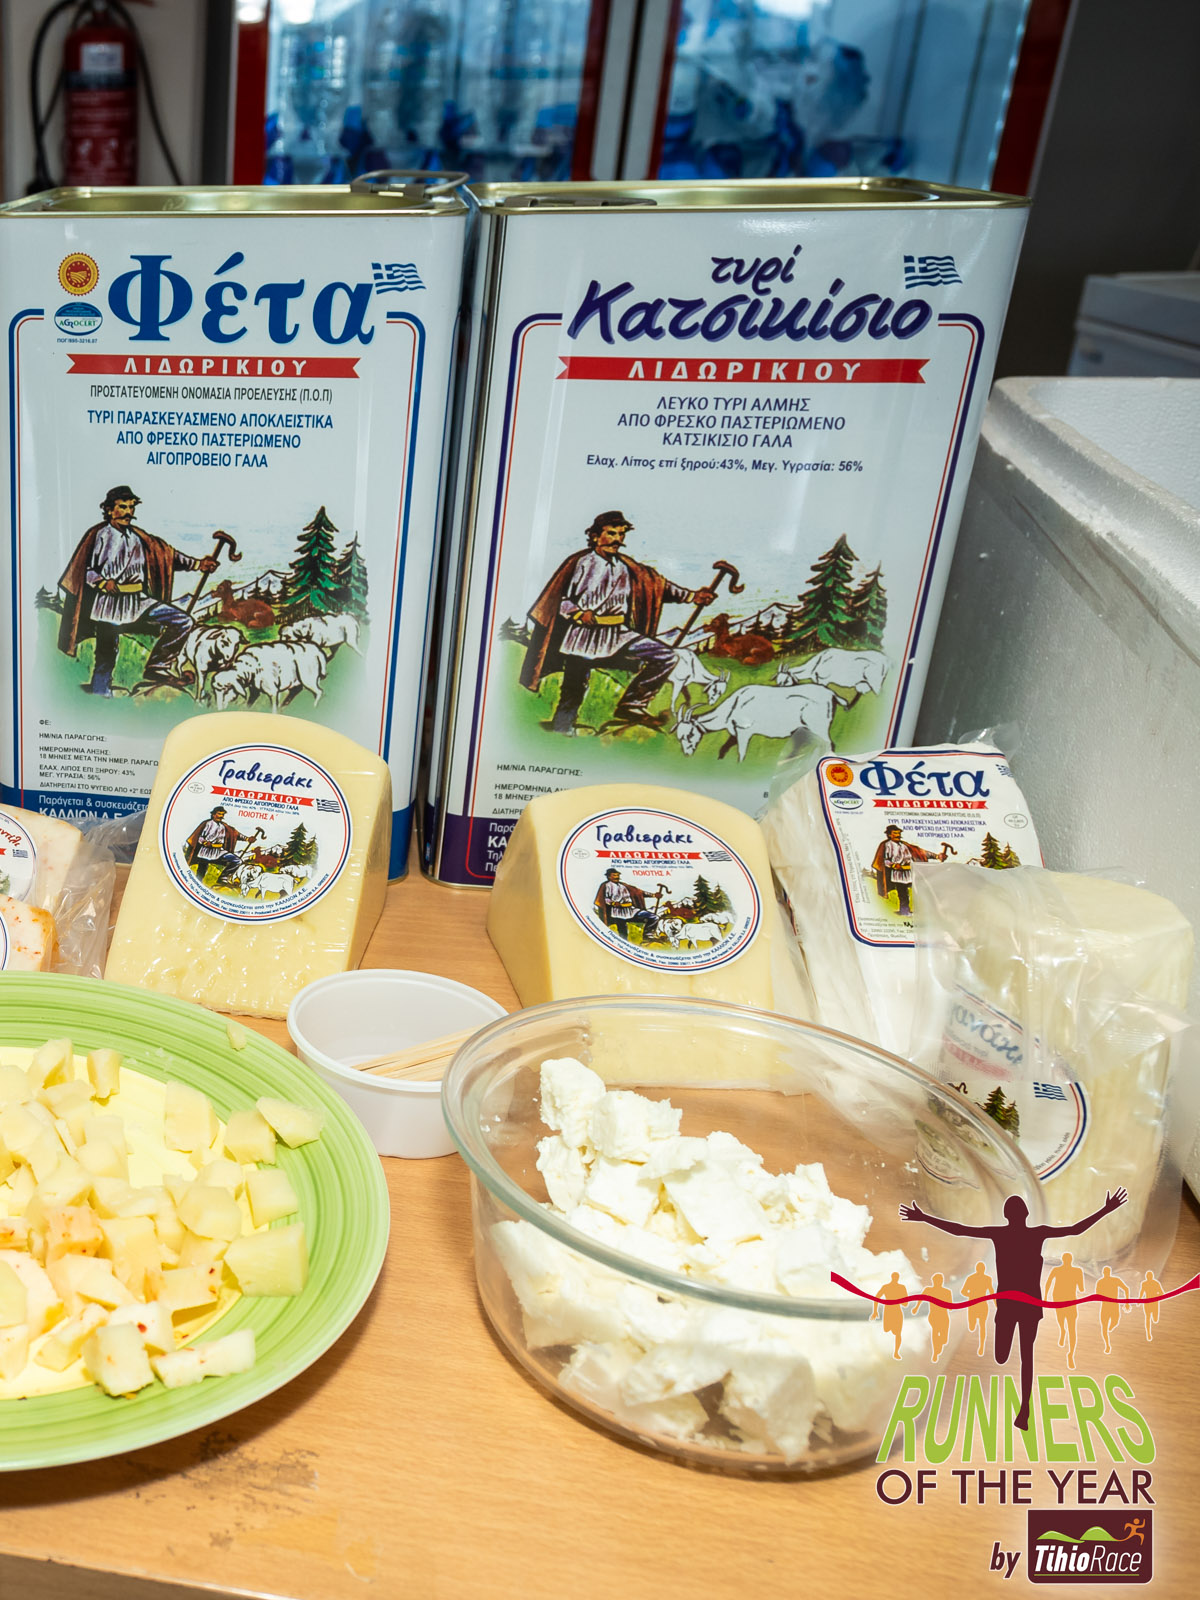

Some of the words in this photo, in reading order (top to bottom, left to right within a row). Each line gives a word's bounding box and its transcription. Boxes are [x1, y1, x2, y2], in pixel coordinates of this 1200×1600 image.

[711, 245, 802, 294] τυρί
[108, 251, 375, 344] Φέτα
[567, 279, 933, 344] Κατσικίσιο
[124, 358, 307, 375] ΛΙΔΩΡΙΚΙΟΥ
[628, 361, 862, 381] ΛΙΔΩΡΙΚΙΟΥ
[90, 385, 179, 399] ΠΡΟΣΤΑΤΕΥΟΜΕΝΗ
[181, 387, 231, 400] ΟΝΟΜΑΣΙΑ
[234, 388, 297, 401] ΠΡΟΕΛΕΥΣΗΣ
[657, 396, 708, 411] ΛΕΥΚΟ
[712, 397, 747, 411] ΤΥΡΙ
[750, 397, 810, 412] ΑΛΜΗΣ
[88, 410, 114, 424] ΤΥΡΙ
[117, 411, 237, 427] ΠΑΡΑΣΚΕΥΑΣΜΕΝΟ
[239, 413, 333, 429] ΑΠΟΚΛΕΙΣΤΙΚΑ
[617, 414, 650, 428] ΑΠΟ
[654, 414, 716, 429] ΦΡΕΣΚΟ
[720, 415, 845, 430] ΠΑΣΤΕΡΙΩΜΕΝΟ
[116, 431, 144, 445] ΑΠΟ
[147, 431, 198, 447] ΦΡΕΣΚΟ
[201, 433, 300, 448] ΠΑΣΤΕΡΙΩΜΕΝΟ
[662, 433, 747, 447] ΚΑΤΣΙΚΙΣΙΟ
[752, 434, 792, 448] ΓΑΛΑ
[147, 451, 231, 467] ΑΙΓΟΠΡΟΒΕΙΟ
[235, 453, 268, 468] ΓΑΛΑ
[586, 454, 618, 467] Ελαχ.
[621, 455, 655, 470] Λίπος
[658, 456, 677, 470] επί
[751, 460, 778, 473] Μεγ.
[782, 460, 835, 474] Υγρασία:
[838, 461, 862, 473] 56%
[64, 734, 107, 742] ΠΑΡΑΓΩΓΗΣ:
[109, 757, 129, 765] ΗΜΕΡ.
[95, 767, 120, 775] ΞΗΡΟΥ:
[218, 759, 313, 791] Γραβιεράκι
[497, 764, 526, 772] ΗΜ/ΝΙΑ
[529, 766, 583, 776] ΠΑΡΑΓΩΓΗΣ:
[859, 761, 990, 798] Φέτα
[495, 784, 552, 793] ΗΜΕΡΟΜΗΝΙΑ
[39, 795, 84, 806] Παράγεται
[86, 795, 92, 806] &
[224, 789, 302, 805] ΛΙΔΩΡΙΚΙΟΥ
[887, 800, 973, 809] ΛΙΔΩΡΙΚΙΟΥ
[238, 810, 268, 820] ΠΟΙΟΤΗΣ
[596, 825, 693, 848] Γραβιεράκι
[609, 851, 690, 859] ΛΙΔΩΡΙΚΙΟΥ
